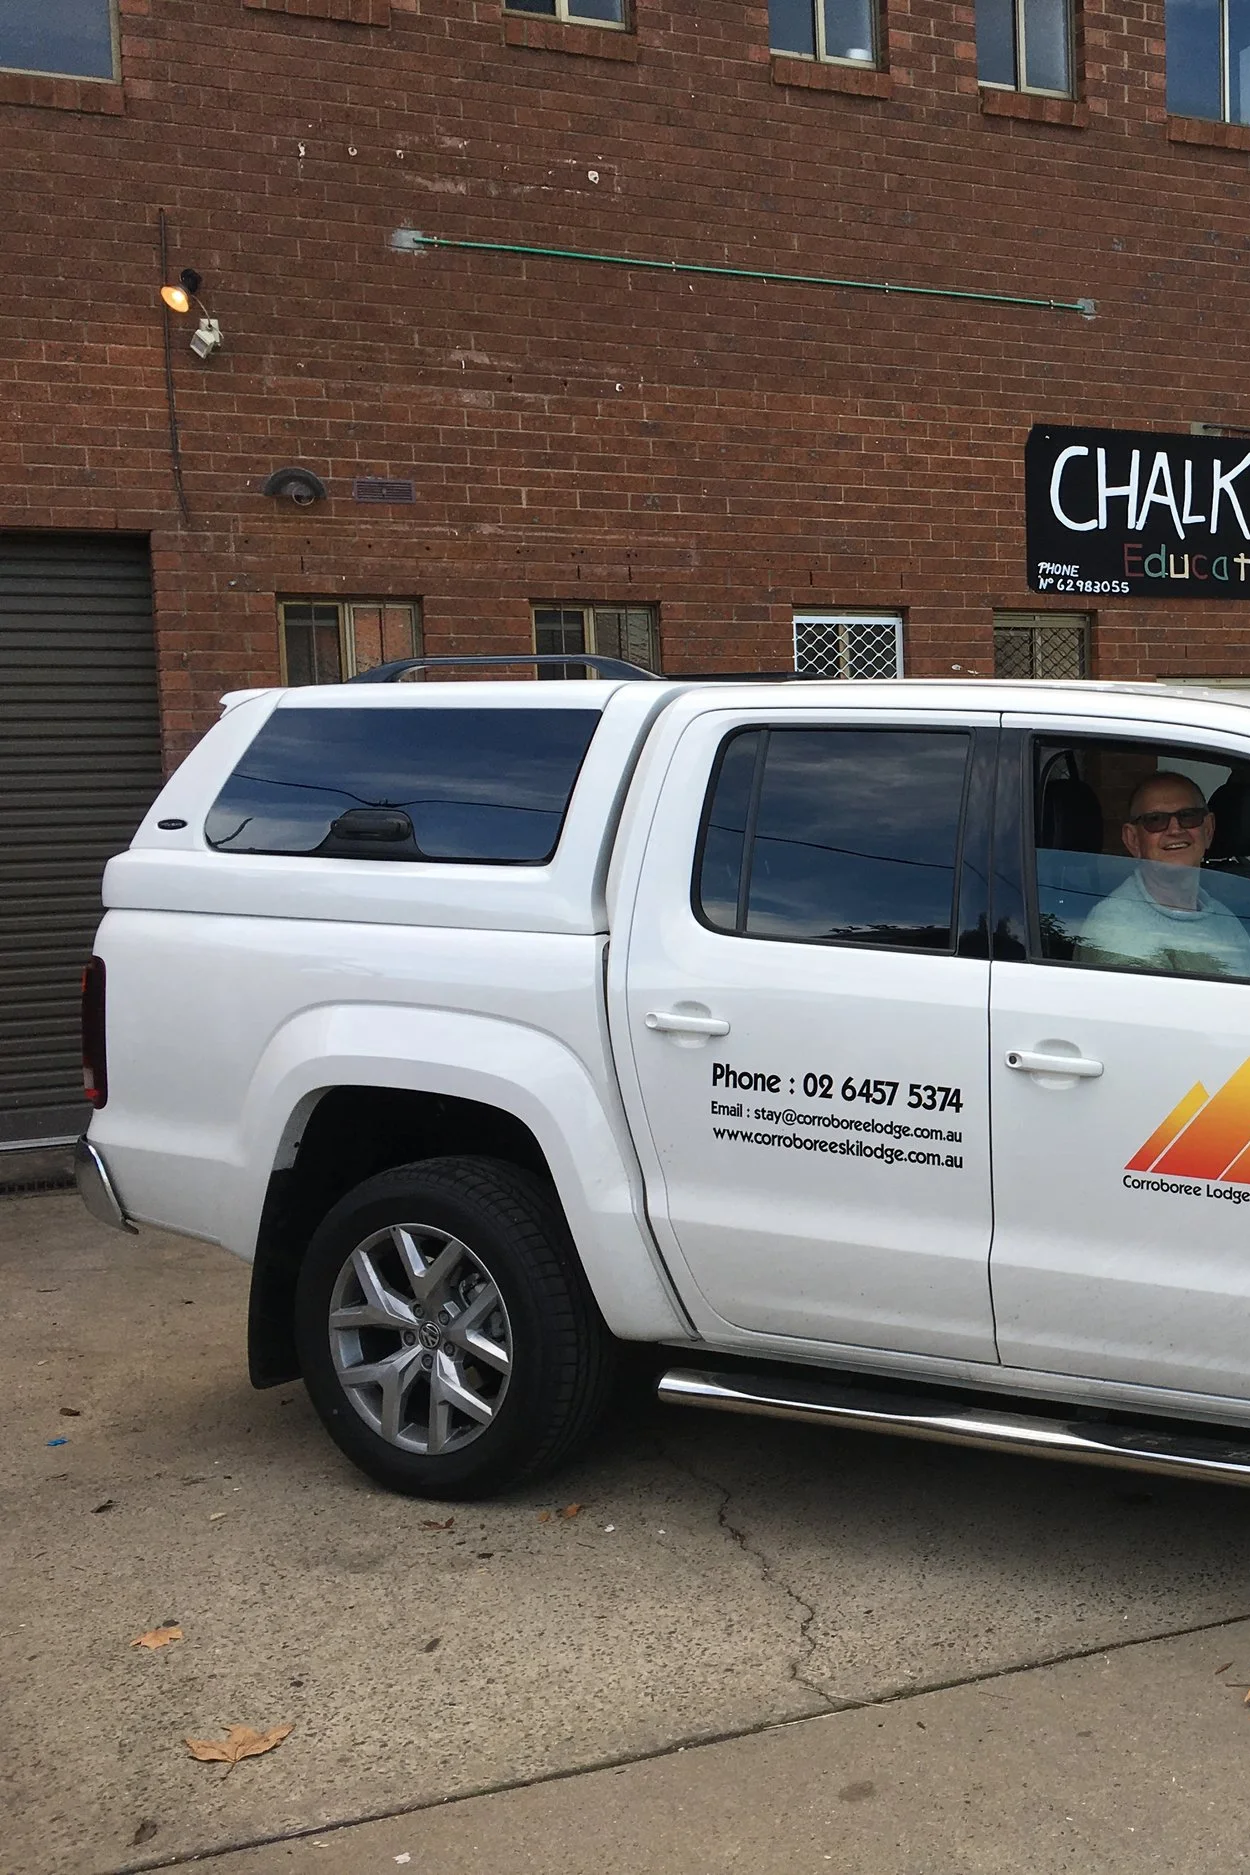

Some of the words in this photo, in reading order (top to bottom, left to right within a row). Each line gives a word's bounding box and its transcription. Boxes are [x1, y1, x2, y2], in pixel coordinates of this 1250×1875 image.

[1038, 562, 1080, 577] PHONE
[1056, 579, 1130, 593] 62983055
[712, 1062, 782, 1094] Phone
[803, 1072, 834, 1099] 02
[841, 1076, 899, 1106] 6457
[906, 1083, 963, 1113] 5374
[711, 1100, 743, 1118] Email
[753, 1106, 963, 1143] stay@corroboreelodge.com.au
[712, 1126, 964, 1169] www.corroboreeskilodge.com.au
[1122, 1174, 1202, 1197] Corroboree
[1206, 1183, 1250, 1205] Lodge
